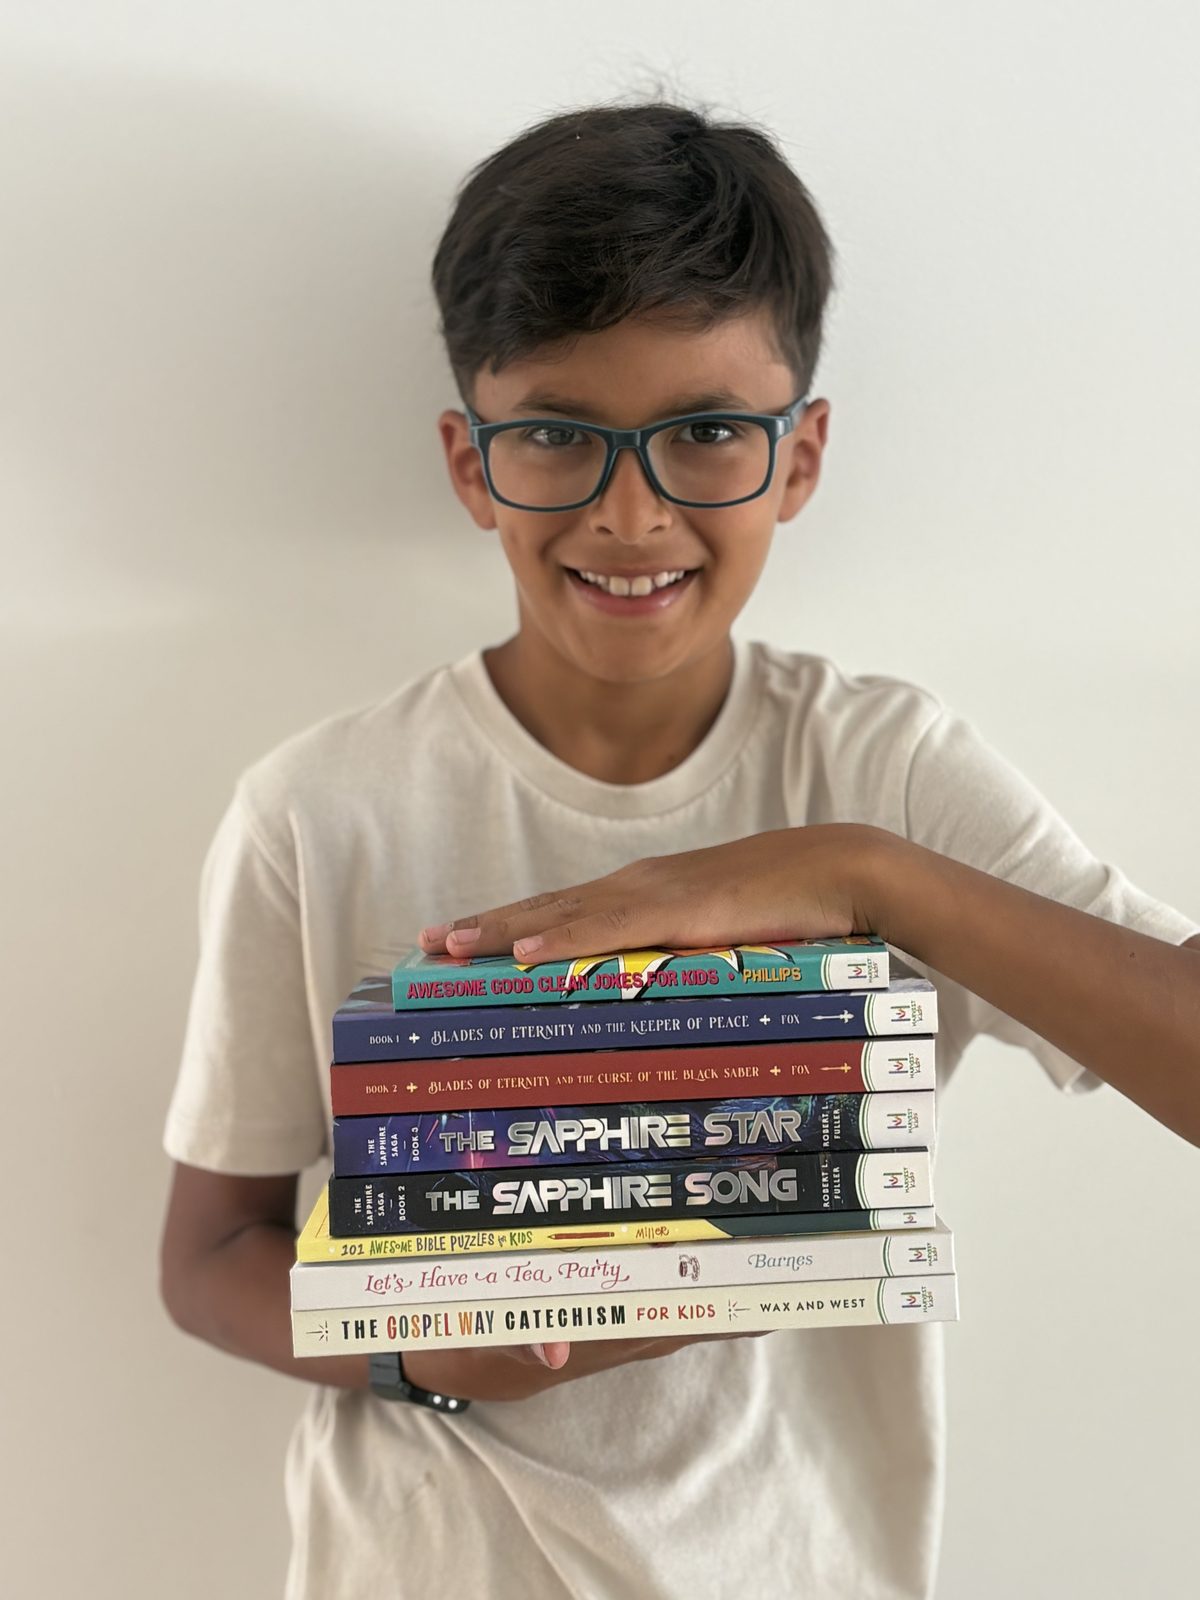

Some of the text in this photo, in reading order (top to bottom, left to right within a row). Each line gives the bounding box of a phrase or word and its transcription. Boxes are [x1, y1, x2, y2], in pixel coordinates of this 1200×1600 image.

[406, 967, 802, 1000] AWESOME GOOD CLEAN JOKES FOR KIDS PHILLIPS
[369, 1035, 393, 1045] BOOK
[431, 1027, 484, 1046] BLADES
[490, 1027, 506, 1040] OF
[512, 1023, 575, 1040] ETERNITY
[580, 1022, 601, 1035] AND
[606, 1022, 626, 1033] THE
[630, 1018, 680, 1035] KEEPER
[687, 1017, 703, 1030] OF
[709, 1015, 750, 1029] PEACE
[781, 1013, 800, 1025] FOX
[366, 1085, 389, 1094] BOOK
[428, 1080, 473, 1095] BLADES
[478, 1079, 492, 1089] OF
[497, 1076, 551, 1090] ETERNITY
[556, 1075, 574, 1085] AND
[577, 1075, 594, 1084] THE
[598, 1072, 633, 1084] CURSE
[638, 1072, 652, 1082] OF
[656, 1070, 678, 1081] THE
[683, 1068, 719, 1082] BLACK
[724, 1067, 760, 1078] SABER
[791, 1065, 810, 1076] FOX
[439, 1109, 802, 1156] THE SAPPHIRE STAR
[822, 1112, 830, 1147] ROBERT
[833, 1108, 841, 1139] FULLER
[367, 1138, 375, 1155] THE
[379, 1126, 387, 1167] SAPPHIRE
[391, 1133, 399, 1157] SAGA
[412, 1136, 420, 1162] BOOK
[426, 1169, 797, 1215] THE SAPPHIRE SONG
[822, 1171, 830, 1208] ROBERT
[833, 1166, 841, 1199] FULLER
[366, 1184, 374, 1226] SAPPHIRE
[398, 1195, 406, 1221] BOOK
[341, 1244, 364, 1256] 101
[416, 1235, 446, 1252] BIBLE
[509, 1231, 533, 1246] KIDS
[420, 1265, 468, 1289] Have
[475, 1272, 498, 1284] a
[505, 1260, 552, 1283] Tea
[558, 1257, 630, 1290] Party
[748, 1252, 814, 1272] Barnes
[341, 1297, 866, 1341] THE GOSPEL WAY CATECHISM FOR KIDS WAX AND WEST
